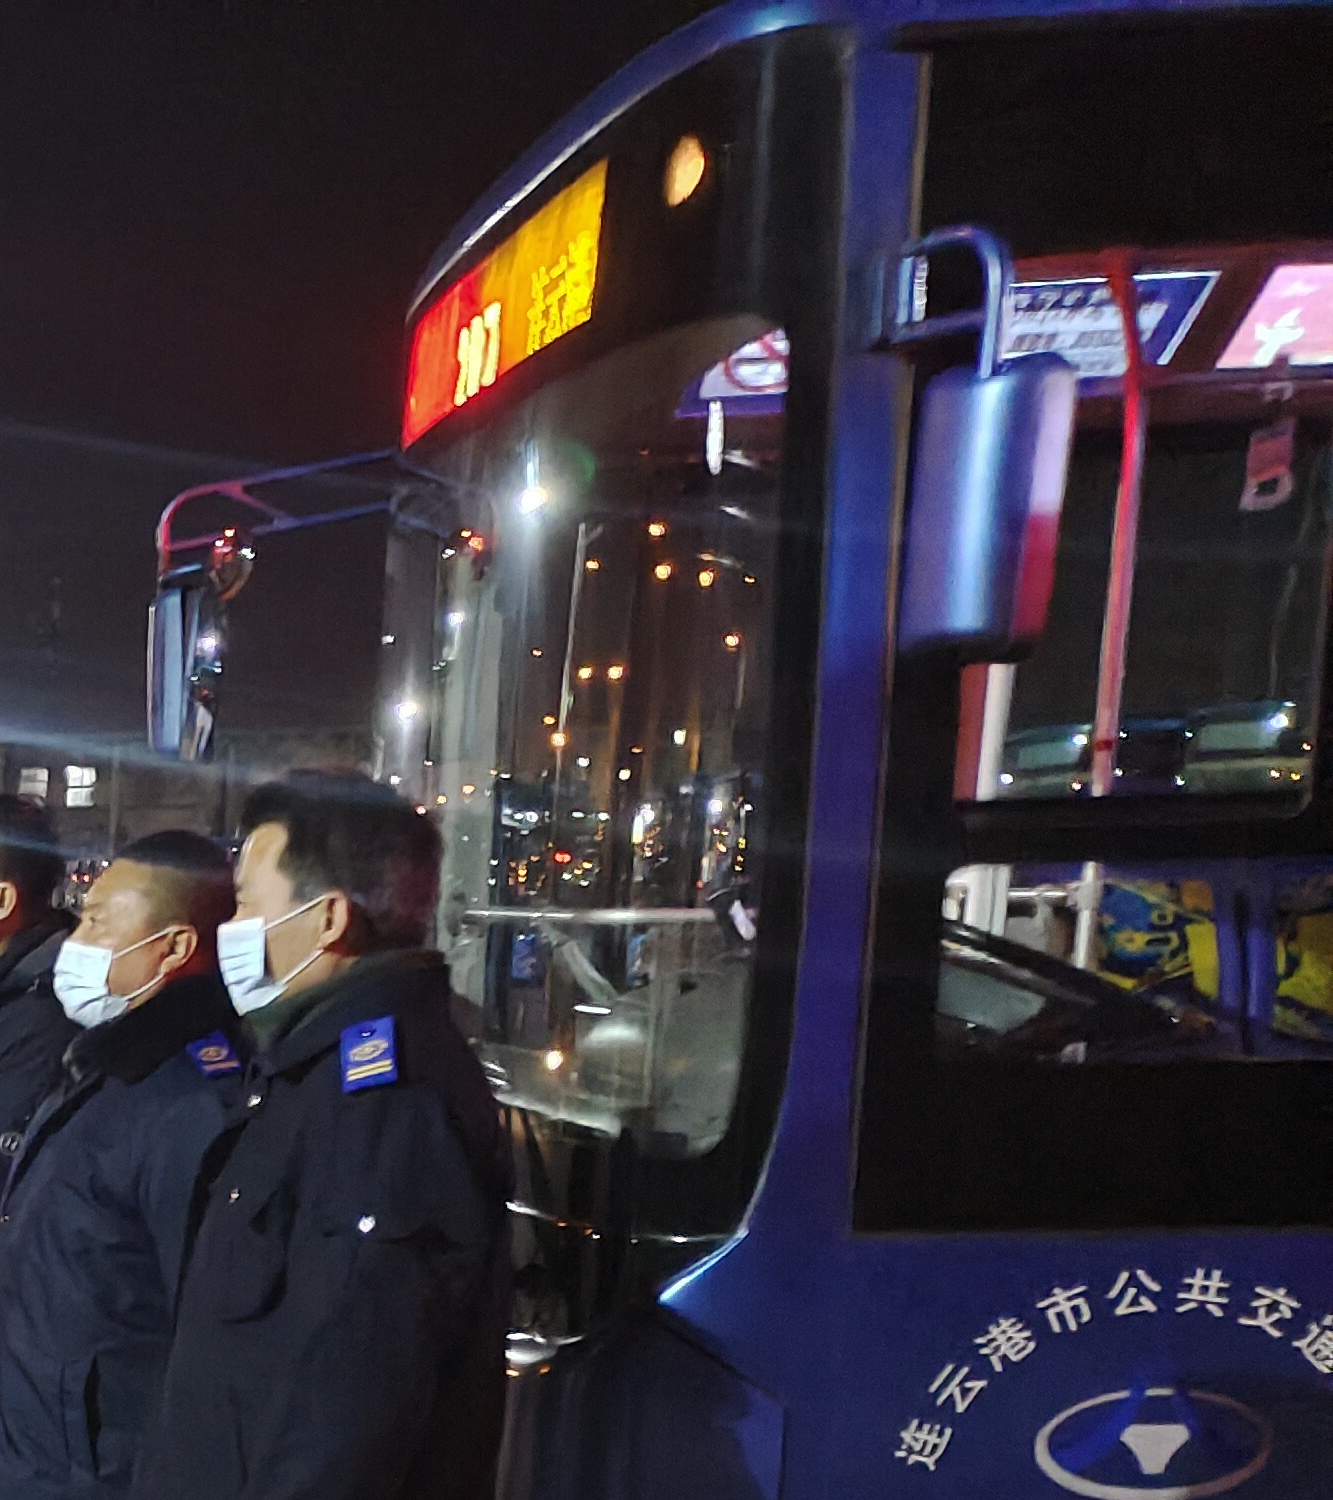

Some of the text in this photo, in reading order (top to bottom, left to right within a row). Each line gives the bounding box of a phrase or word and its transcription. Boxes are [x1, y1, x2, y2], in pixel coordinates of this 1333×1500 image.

[894, 1267, 1333, 1471] 连云港市公共交通
